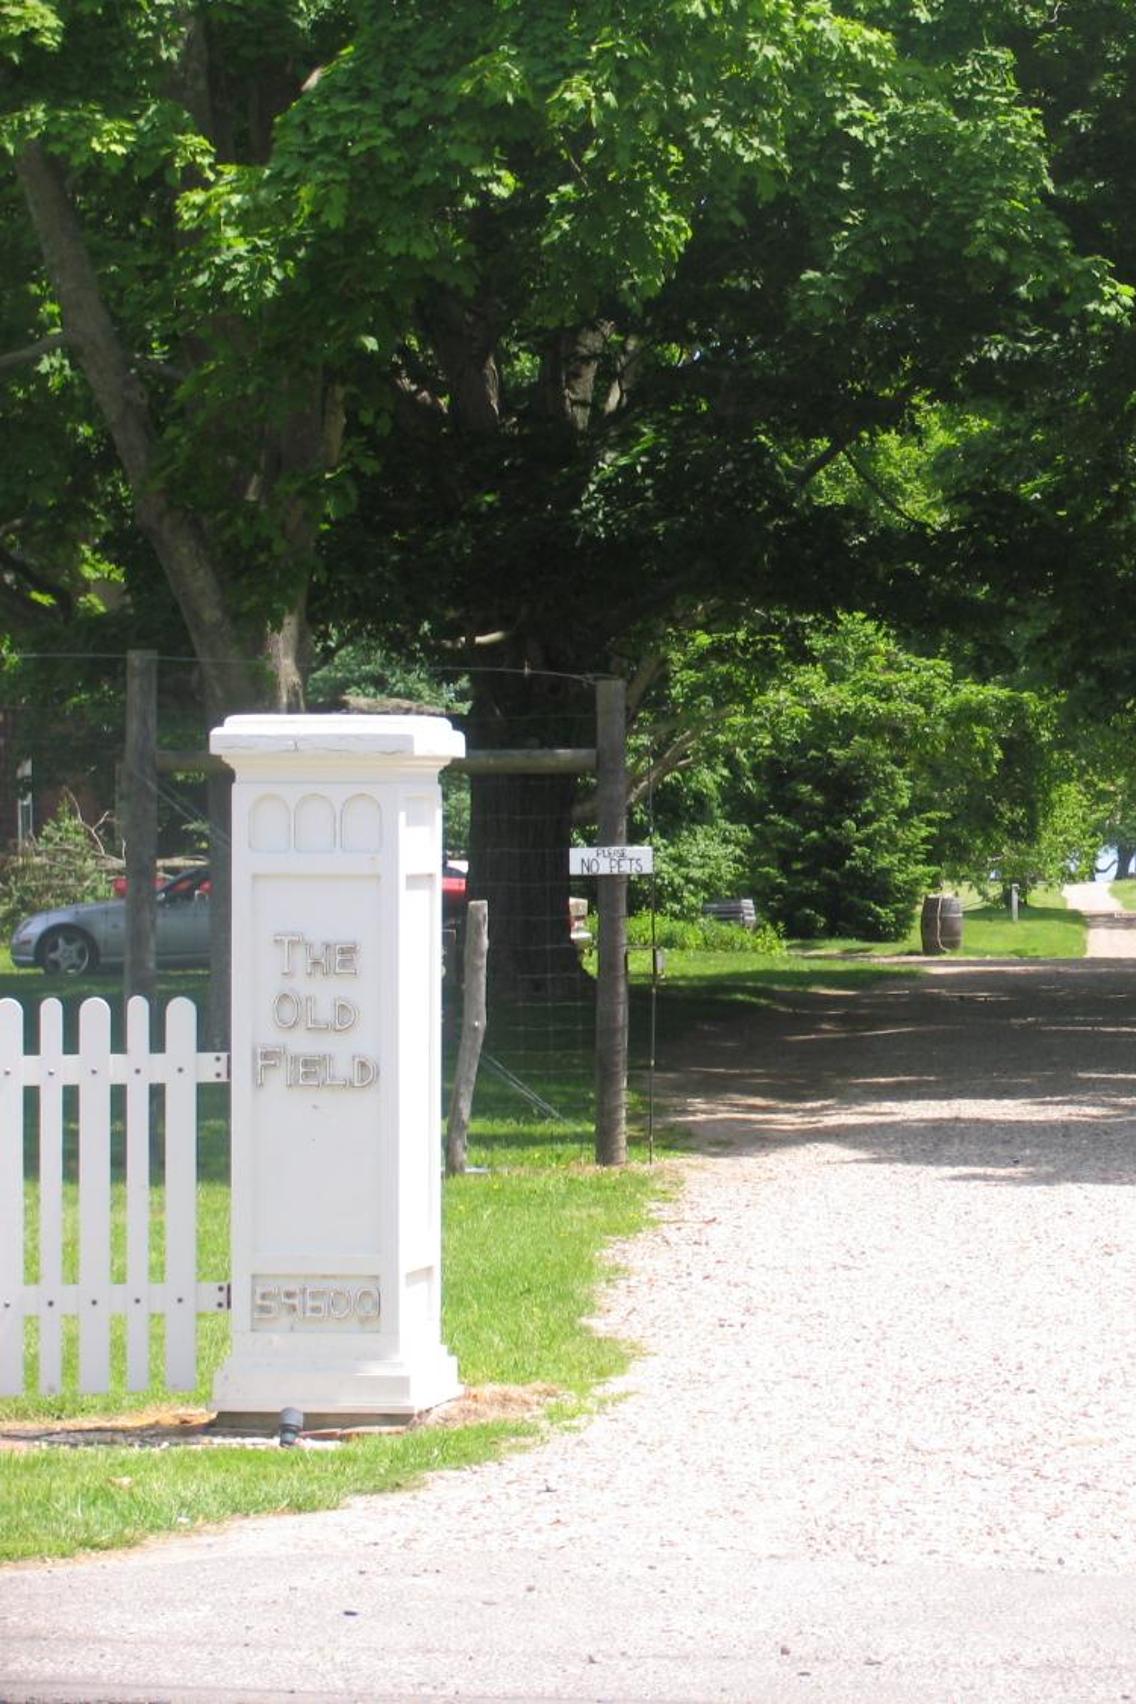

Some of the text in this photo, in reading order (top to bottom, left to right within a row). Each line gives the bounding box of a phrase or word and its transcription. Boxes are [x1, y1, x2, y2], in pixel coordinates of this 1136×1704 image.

[581, 858, 643, 873] NO PETS
[274, 933, 360, 976] THE
[273, 992, 358, 1033] OLD
[254, 1044, 379, 1089] FIELD
